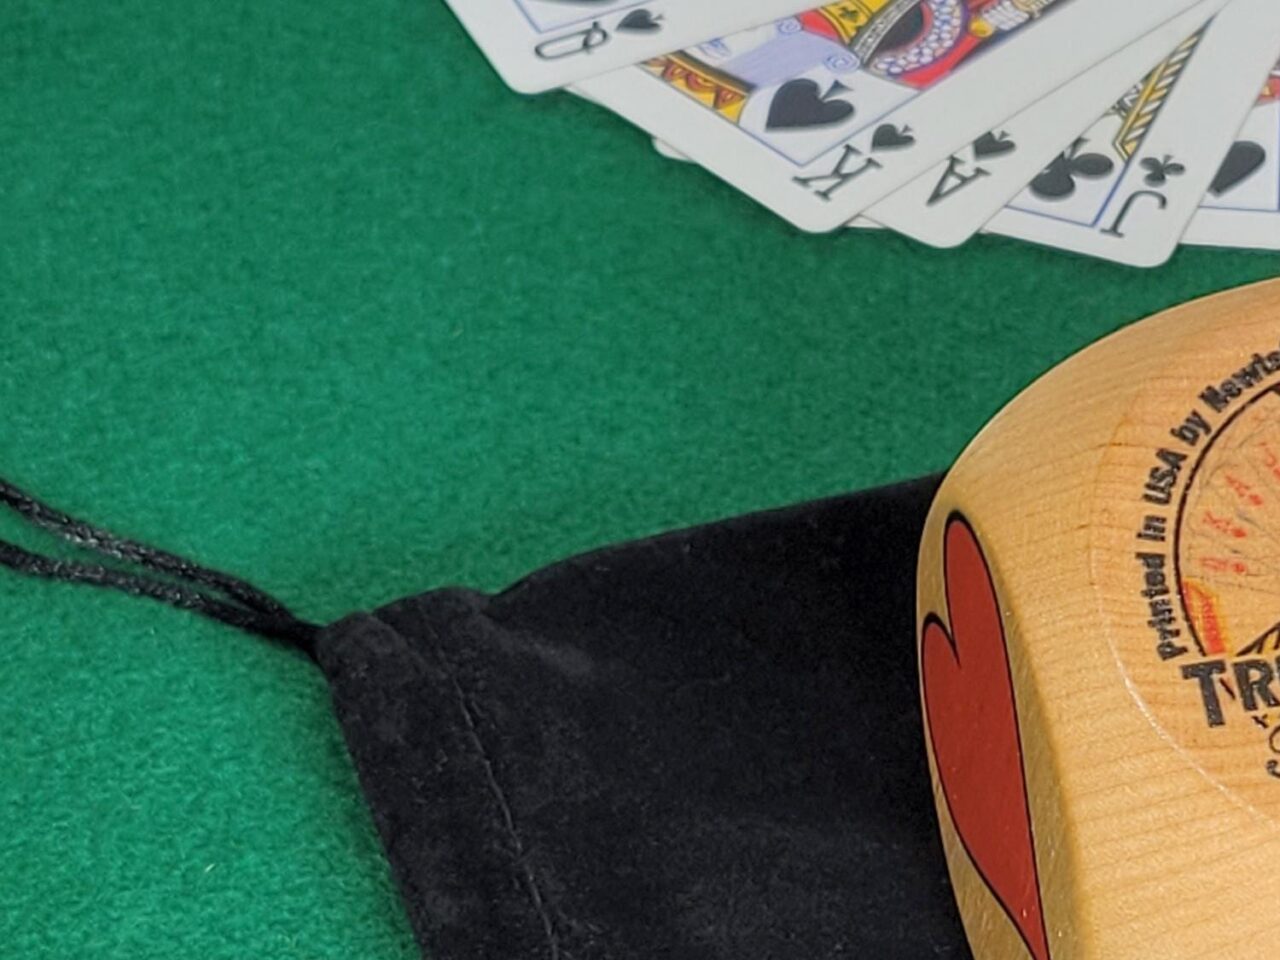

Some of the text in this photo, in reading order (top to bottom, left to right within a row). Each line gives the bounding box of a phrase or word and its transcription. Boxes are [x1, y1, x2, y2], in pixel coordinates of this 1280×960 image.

[534, 20, 608, 60] Q
[792, 144, 883, 202] K
[926, 154, 992, 206] A
[1100, 190, 1168, 238] J
[1171, 408, 1212, 446] by
[1142, 448, 1188, 505] USA
[1136, 515, 1167, 542] in
[1135, 552, 1188, 661] Printed
